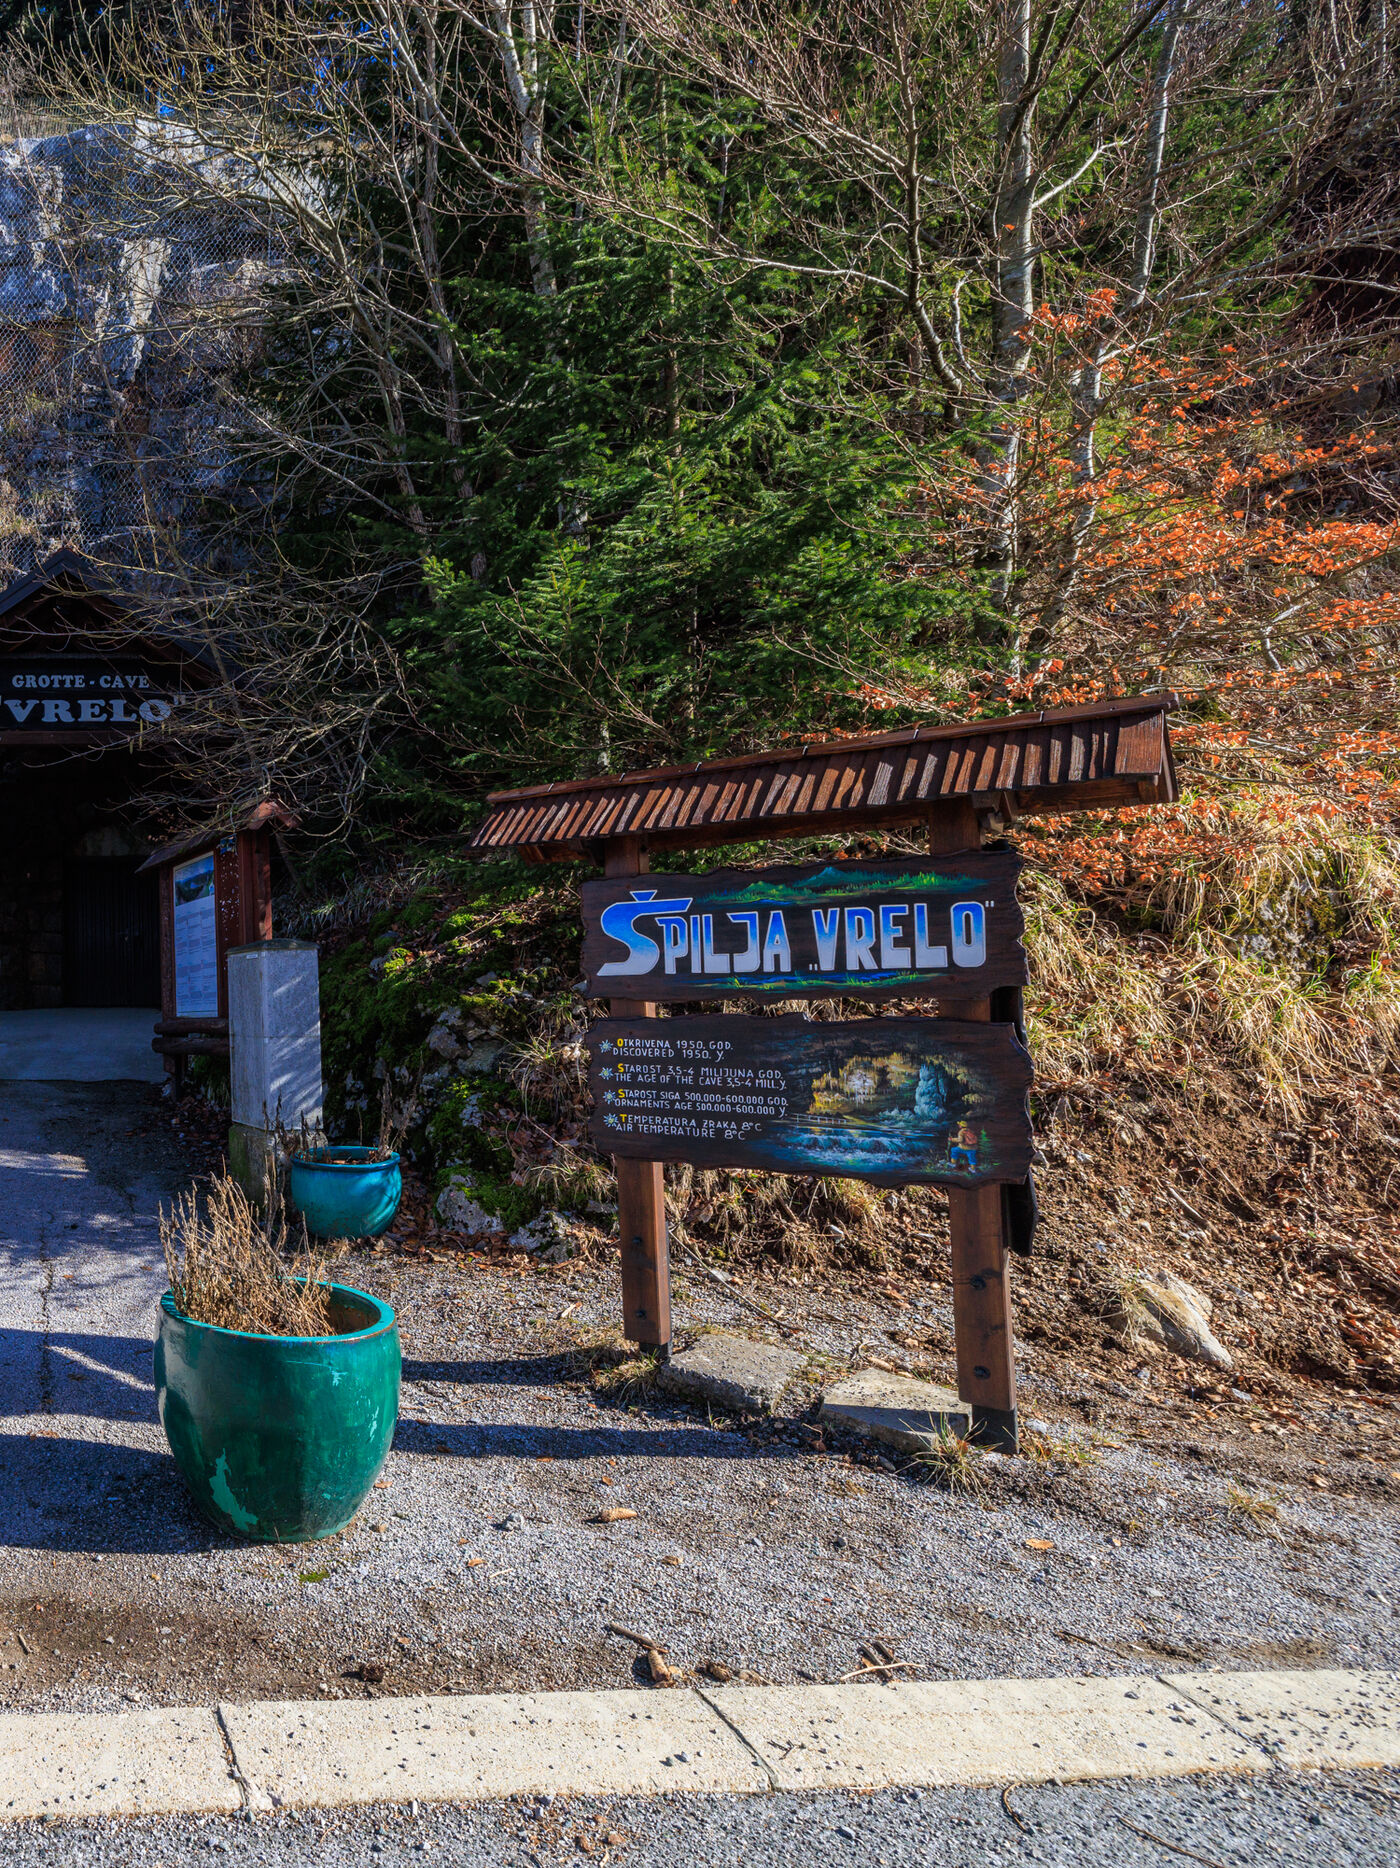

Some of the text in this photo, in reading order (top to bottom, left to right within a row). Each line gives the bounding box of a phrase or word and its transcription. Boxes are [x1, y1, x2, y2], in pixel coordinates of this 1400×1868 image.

[12, 675, 85, 688] GROTTE
[100, 675, 149, 688] CAVE
[596, 889, 791, 976] ŠPILJA
[617, 1038, 734, 1050] OTKRIVENA 1950. GOD.
[613, 1048, 675, 1057] DISCOVERED
[682, 1049, 712, 1059] 1950.
[617, 1063, 661, 1073] STAROST
[700, 1067, 754, 1078] MILIJUNA
[758, 1070, 784, 1079] GOD.
[615, 1073, 632, 1082] THE
[637, 1074, 657, 1083] AGE
[660, 1075, 670, 1083] OF
[675, 1075, 694, 1085] THE
[699, 1077, 723, 1086] CAVE
[618, 1089, 789, 1106] STAROST SIGA 500.000-600.000 GOD.
[614, 1098, 670, 1109] ORNAMENTS
[673, 1102, 693, 1110] AGE
[696, 1103, 775, 1115] 500.000-600.000
[619, 1114, 697, 1127] TEMPERATURA
[703, 1119, 737, 1130] ZRAKA
[615, 1124, 633, 1132] AIR
[638, 1124, 716, 1138] TEMPERATURE
